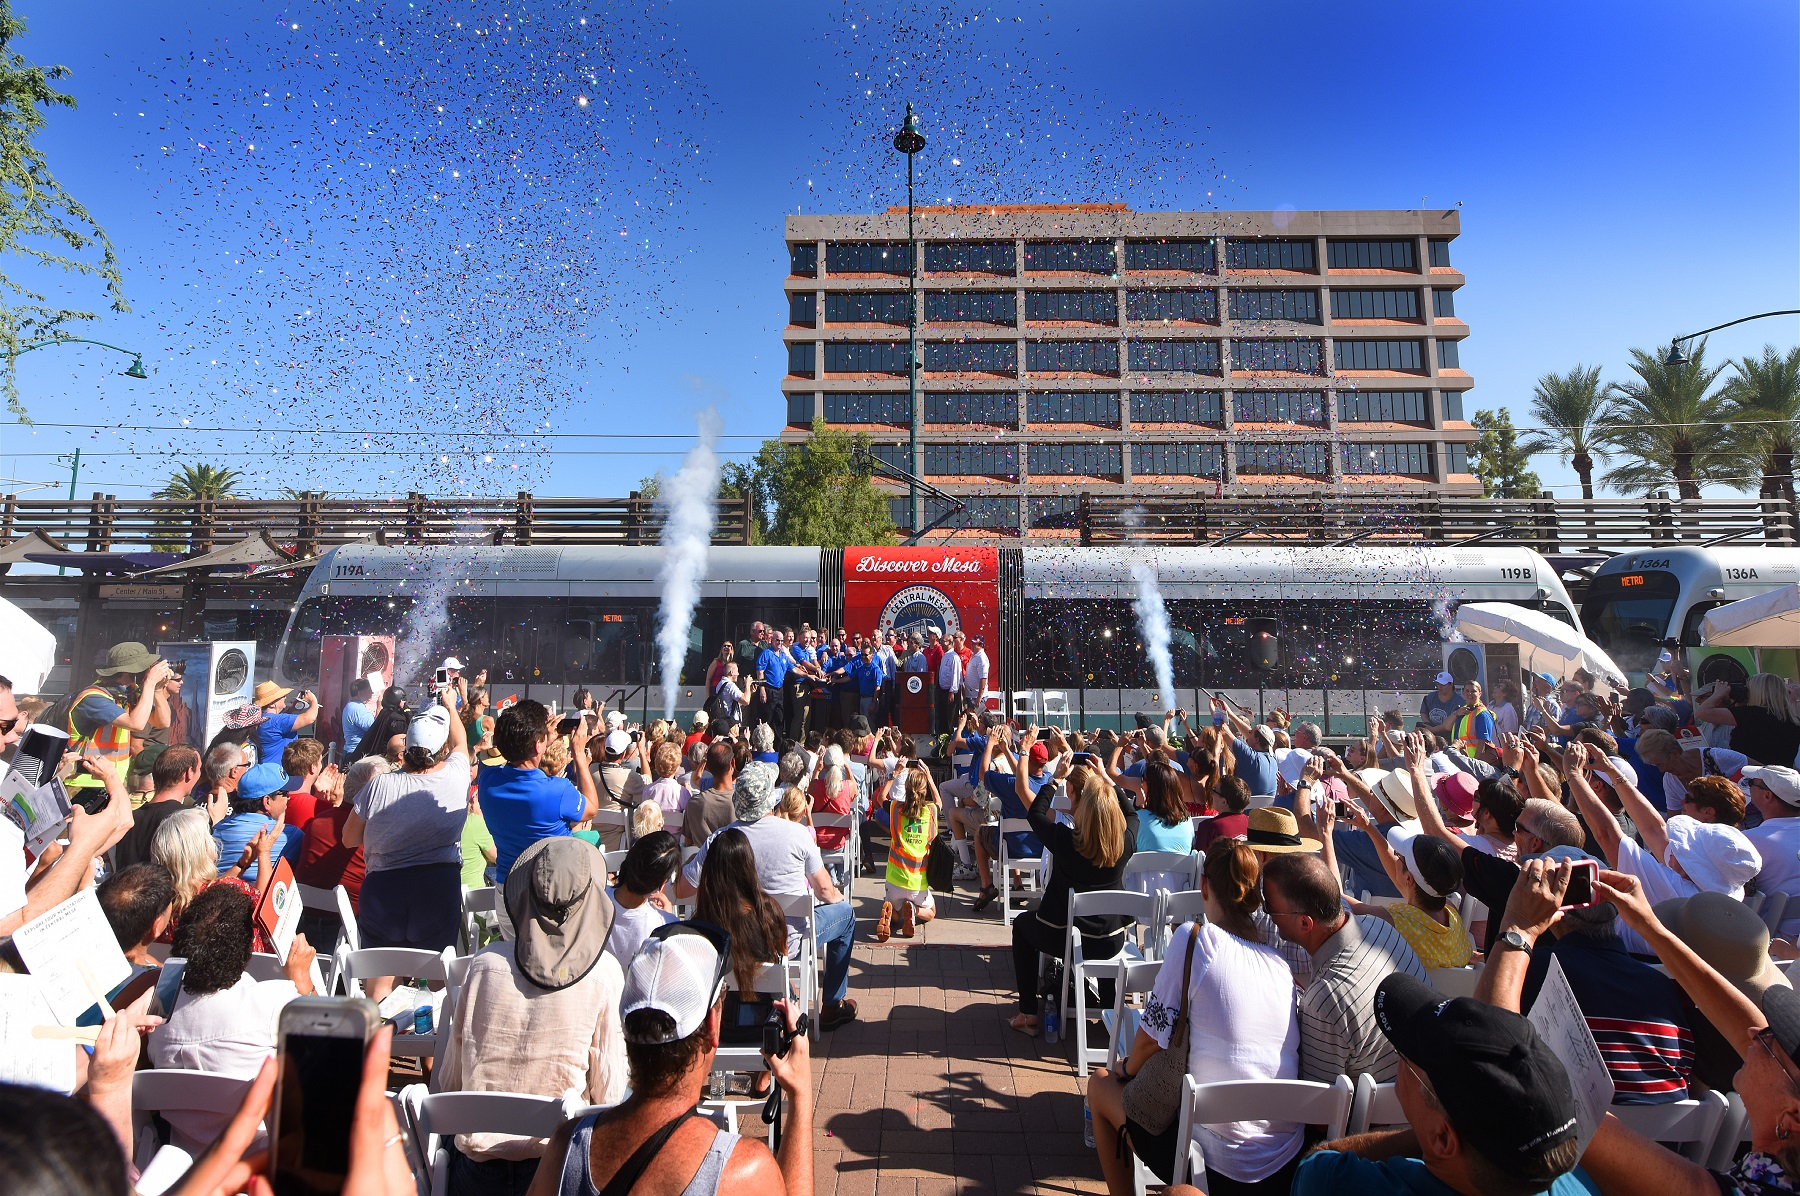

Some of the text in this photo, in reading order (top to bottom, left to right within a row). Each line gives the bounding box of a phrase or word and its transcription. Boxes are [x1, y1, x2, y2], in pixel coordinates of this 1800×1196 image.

[856, 556, 981, 573] Discover Mesa
[1639, 559, 1670, 569] 136A
[337, 565, 364, 576] 119A
[1500, 568, 1532, 579] 119B
[1725, 568, 1759, 579] 136A
[1621, 575, 1644, 587] METRO
[890, 592, 948, 615] CENTRAL MESA
[603, 614, 622, 622] METRO
[1377, 990, 1393, 1032] DISC GOLF
